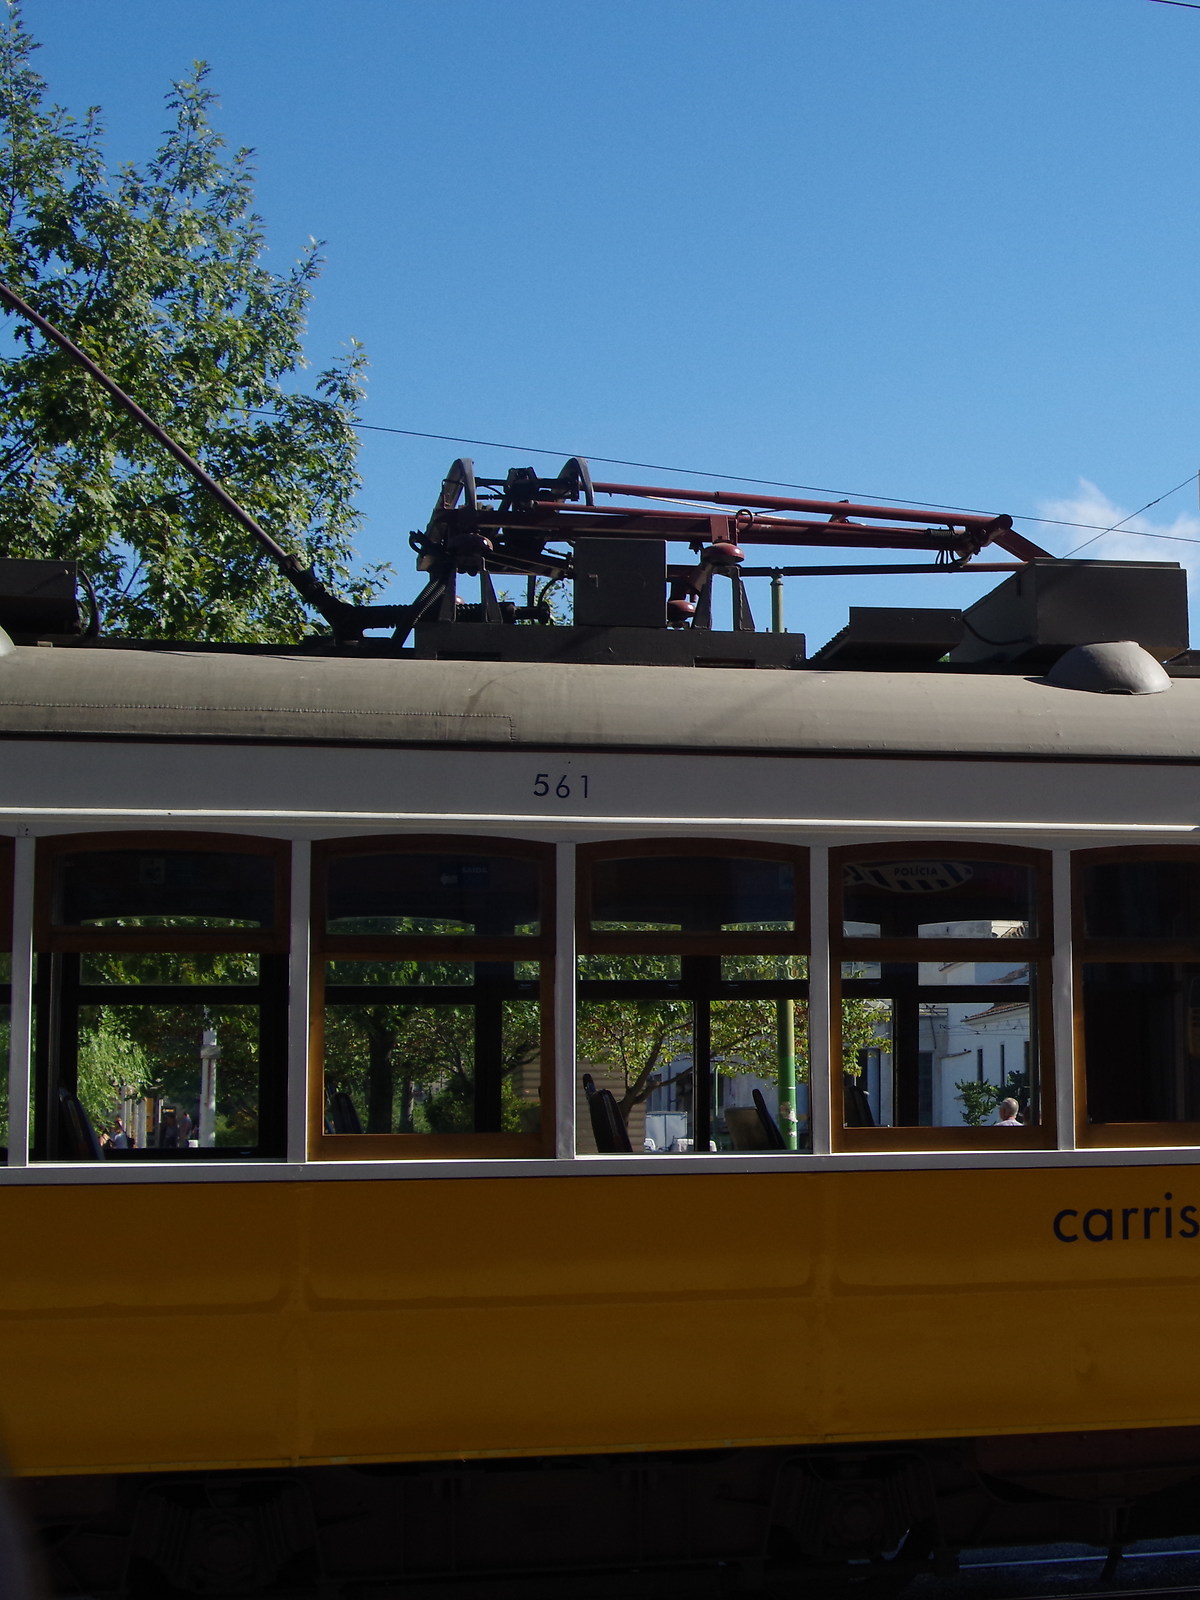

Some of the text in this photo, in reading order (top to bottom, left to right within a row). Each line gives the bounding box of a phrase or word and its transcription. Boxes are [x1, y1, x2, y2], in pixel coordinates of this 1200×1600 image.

[533, 773, 588, 799] 561
[894, 864, 938, 876] POLÍCIA
[1053, 1192, 1200, 1243] carris
